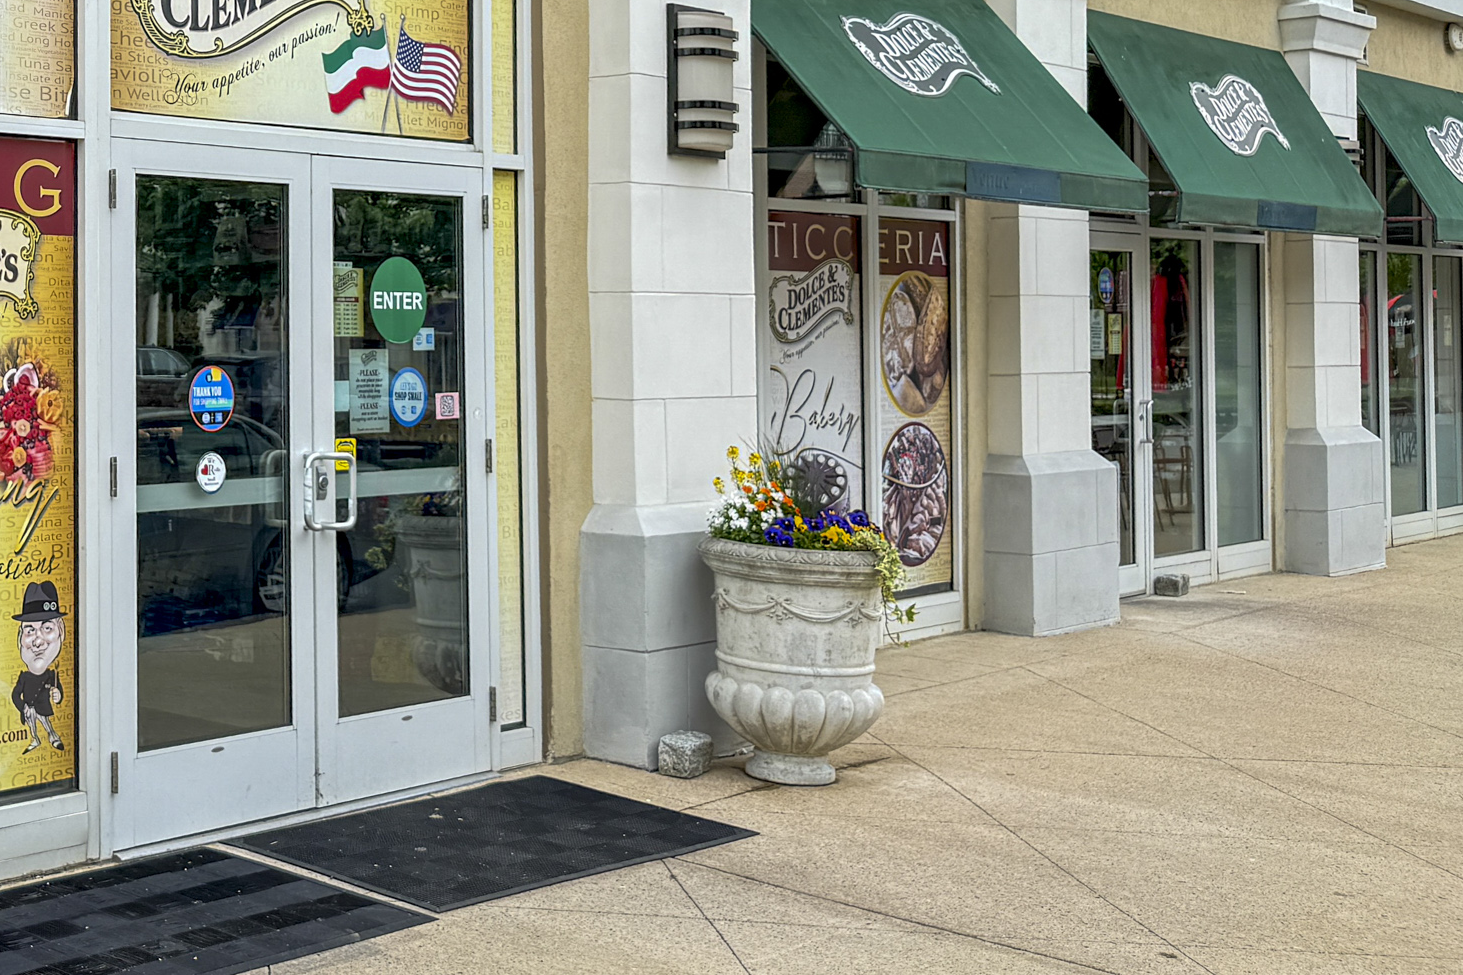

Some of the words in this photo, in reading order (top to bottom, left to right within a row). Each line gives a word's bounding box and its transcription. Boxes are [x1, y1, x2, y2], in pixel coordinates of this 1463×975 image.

[384, 0, 440, 22] Shrimp
[13, 17, 56, 33] Greek
[20, 33, 50, 48] Long
[871, 23, 924, 57] DOLCE
[913, 19, 938, 41] &
[17, 56, 51, 71] Tuna
[128, 50, 169, 66] Sticks
[162, 68, 208, 106] Your
[212, 57, 266, 98] appetite,
[269, 42, 289, 62] our
[291, 12, 341, 59] passion!
[1208, 86, 1241, 120] DOLCE
[787, 271, 826, 310] DOLCE
[828, 264, 838, 283] &
[373, 291, 424, 310] ENTER
[778, 283, 846, 331] CLEMENTE'S
[193, 386, 211, 398] THANK
[211, 386, 222, 397] YOU
[395, 392, 407, 401] SHOP
[408, 391, 423, 401] SMALL
[770, 365, 861, 456] Bakery
[16, 751, 47, 766] Steak
